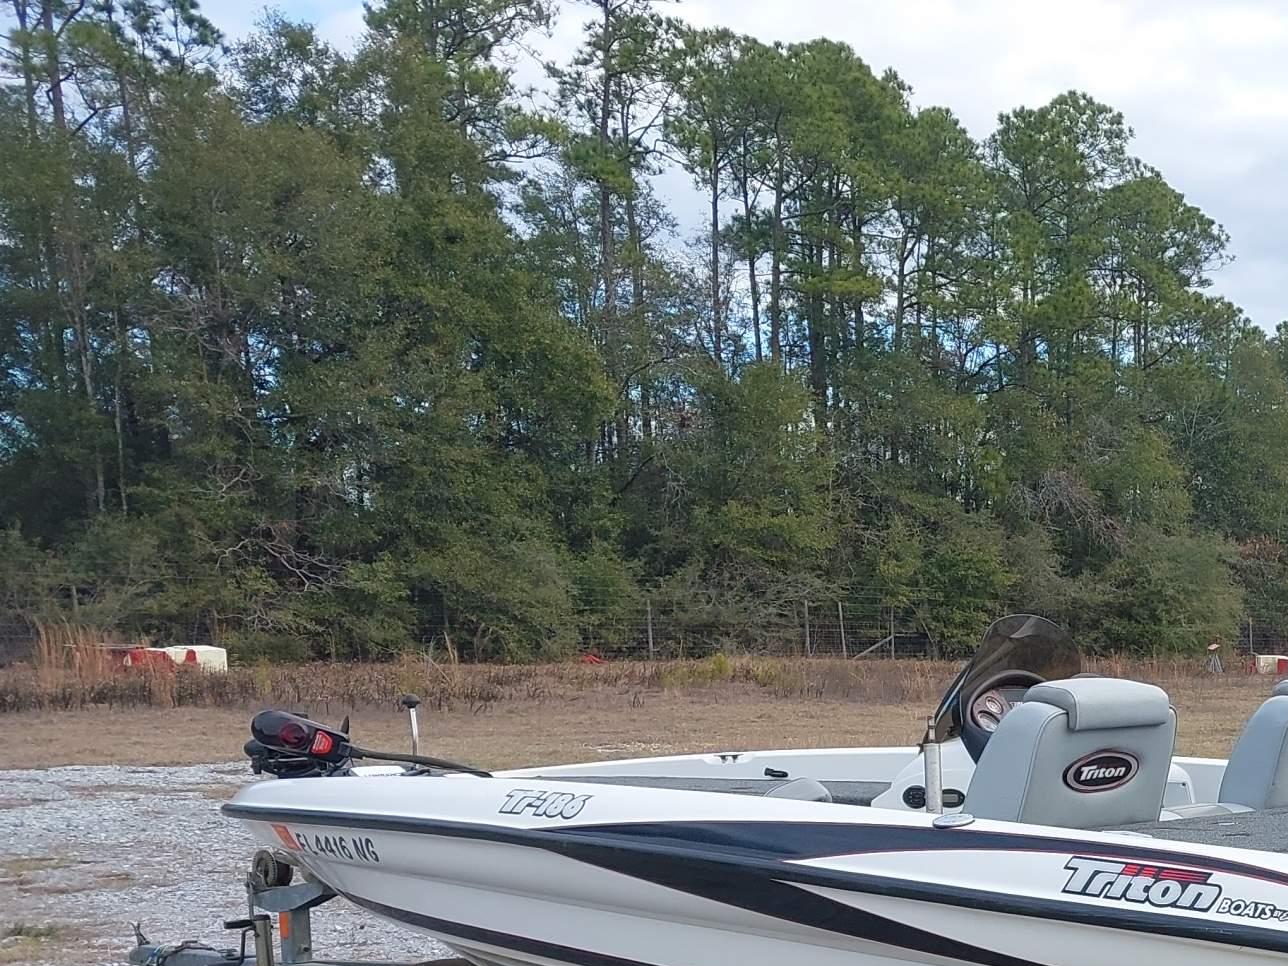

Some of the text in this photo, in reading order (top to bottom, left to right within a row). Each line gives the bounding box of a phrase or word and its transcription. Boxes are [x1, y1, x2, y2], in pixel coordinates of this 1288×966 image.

[1080, 764, 1126, 781] Triton
[352, 836, 380, 863] NG
[1062, 855, 1223, 913] Triton
[1217, 897, 1276, 920] BOATS
